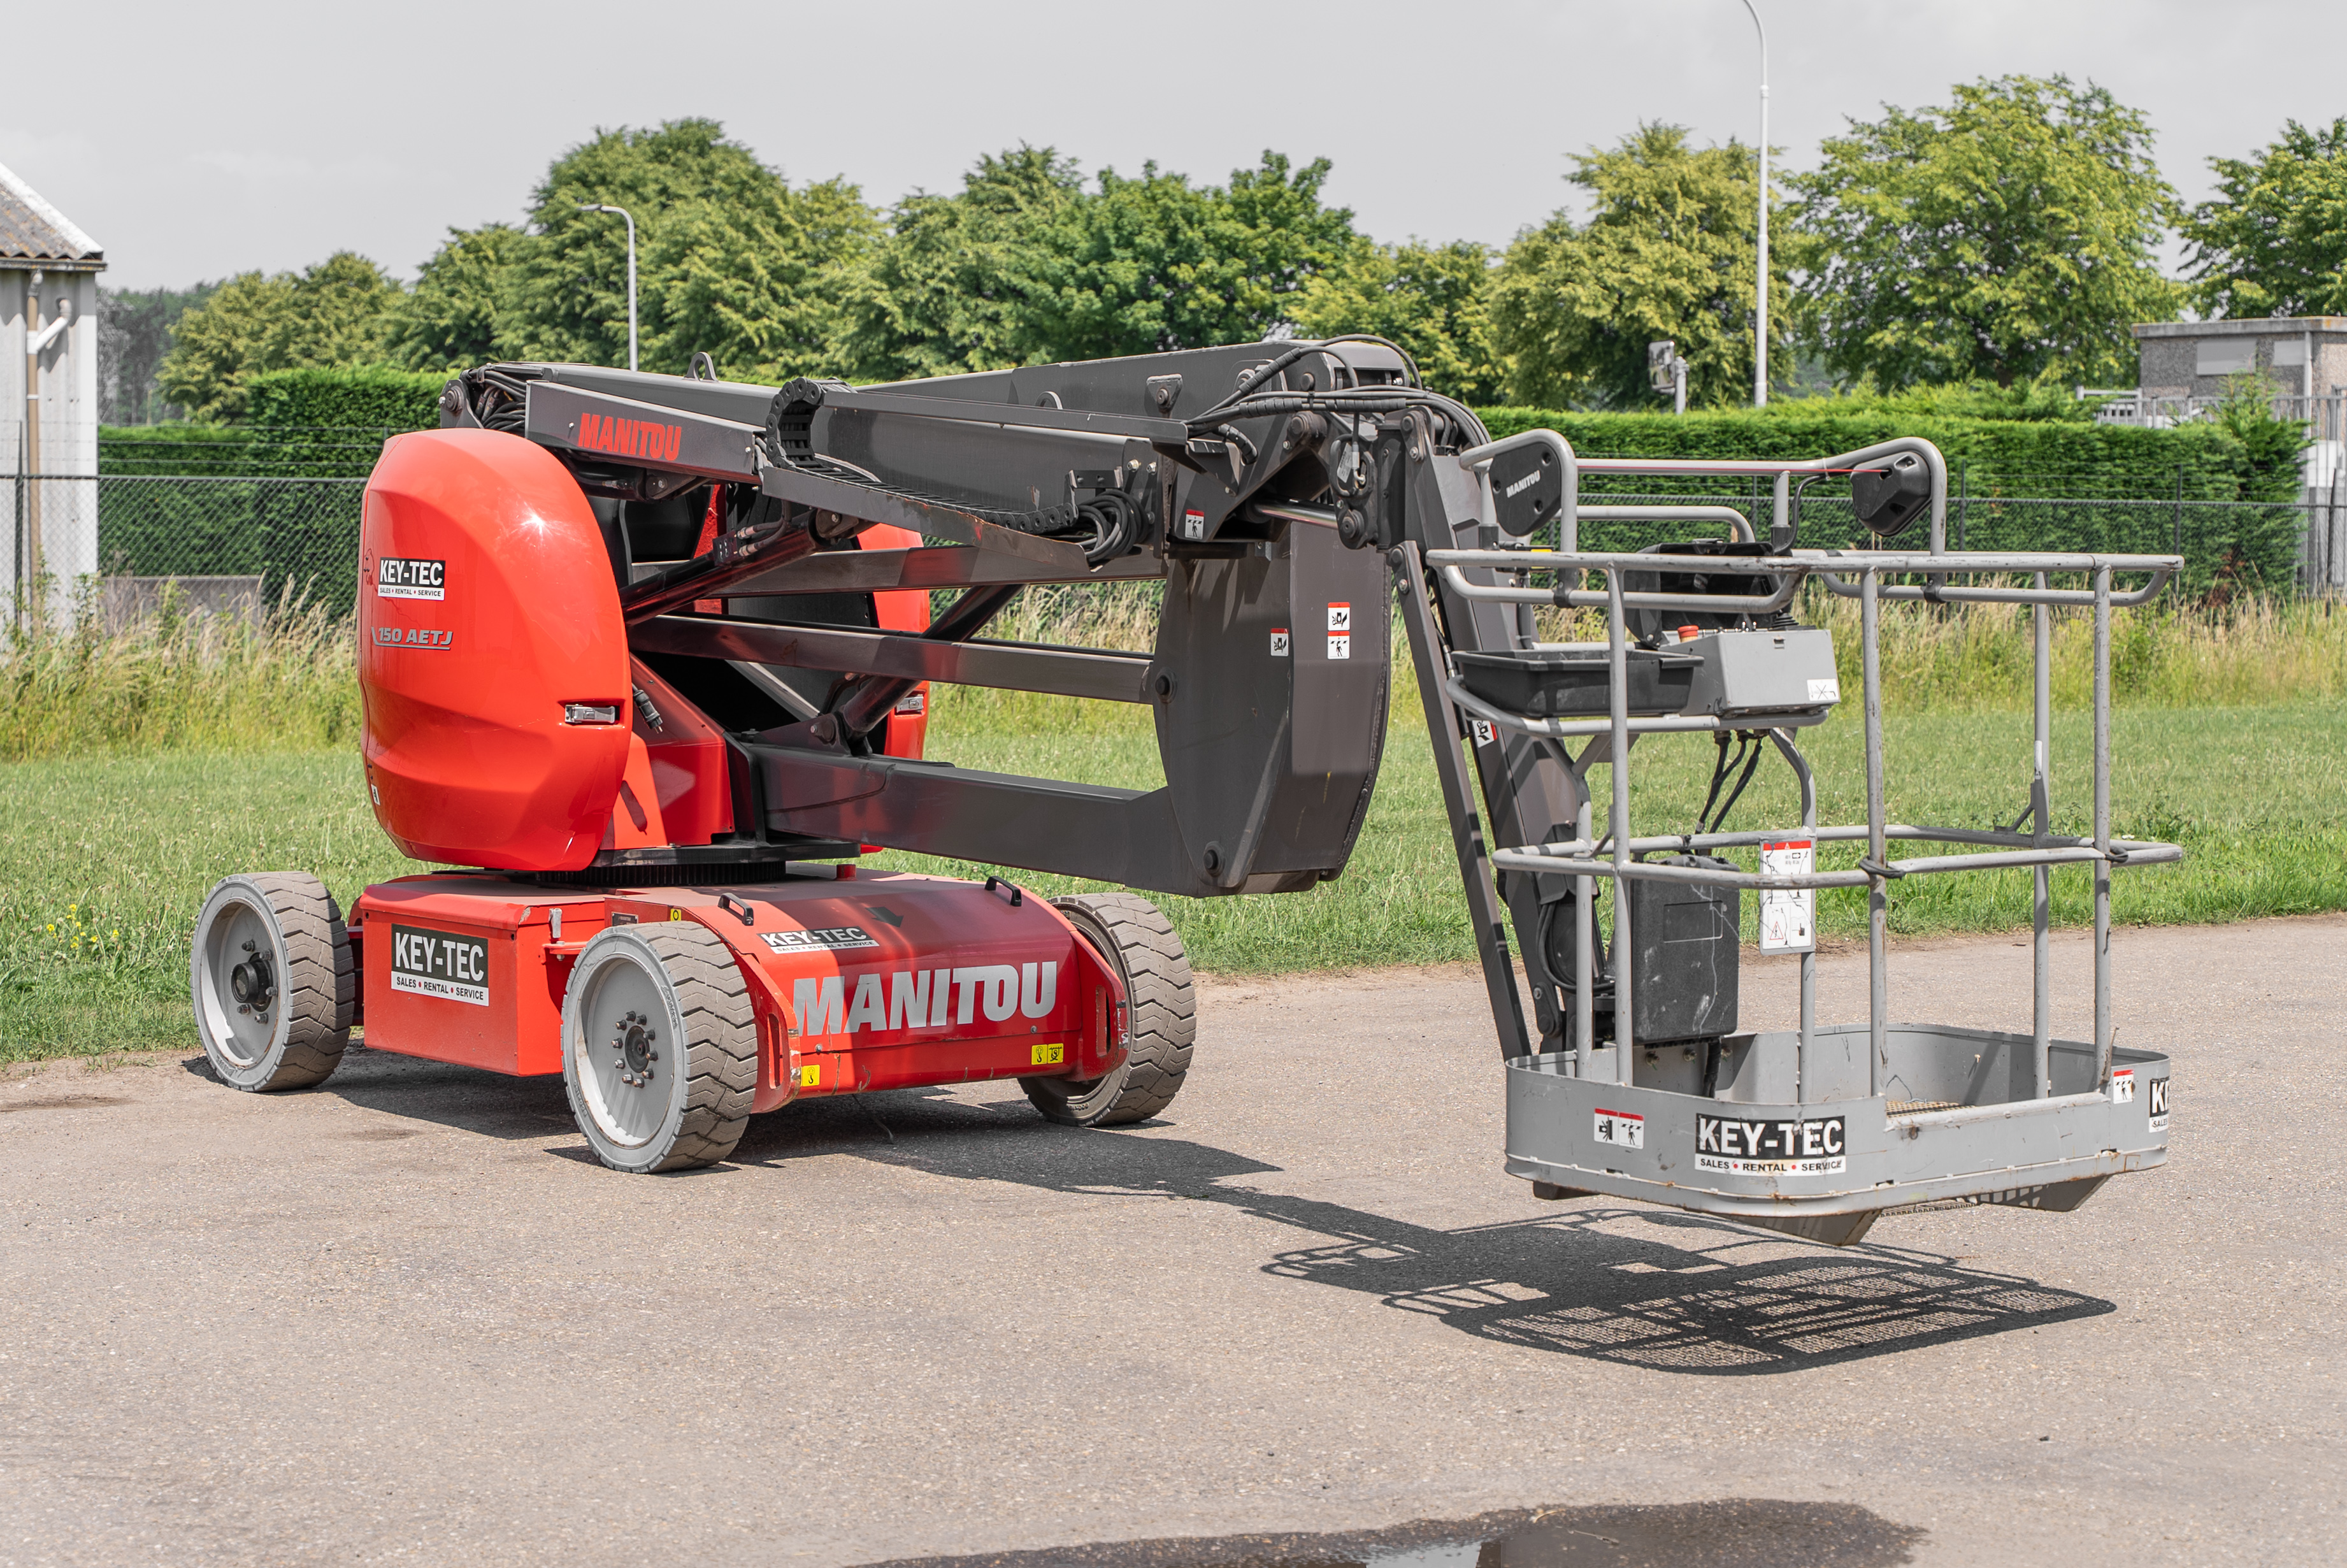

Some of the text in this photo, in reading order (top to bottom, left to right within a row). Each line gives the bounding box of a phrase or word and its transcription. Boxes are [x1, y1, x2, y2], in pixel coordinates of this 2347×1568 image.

[578, 412, 682, 461] MANITOU
[1505, 470, 1540, 498] MANITOU
[380, 559, 443, 586] KEY-TEC
[378, 627, 453, 645] 150 AETJ
[761, 928, 866, 946] KEY-TEC
[395, 932, 484, 982] KEY-TEC
[396, 976, 484, 1000] SALES RENTAL SERVICE
[793, 961, 1057, 1037] MANITOU
[1698, 1118, 1843, 1156] KEY-TEC
[1700, 1158, 1842, 1172] SALES RENTAL SERVICE
